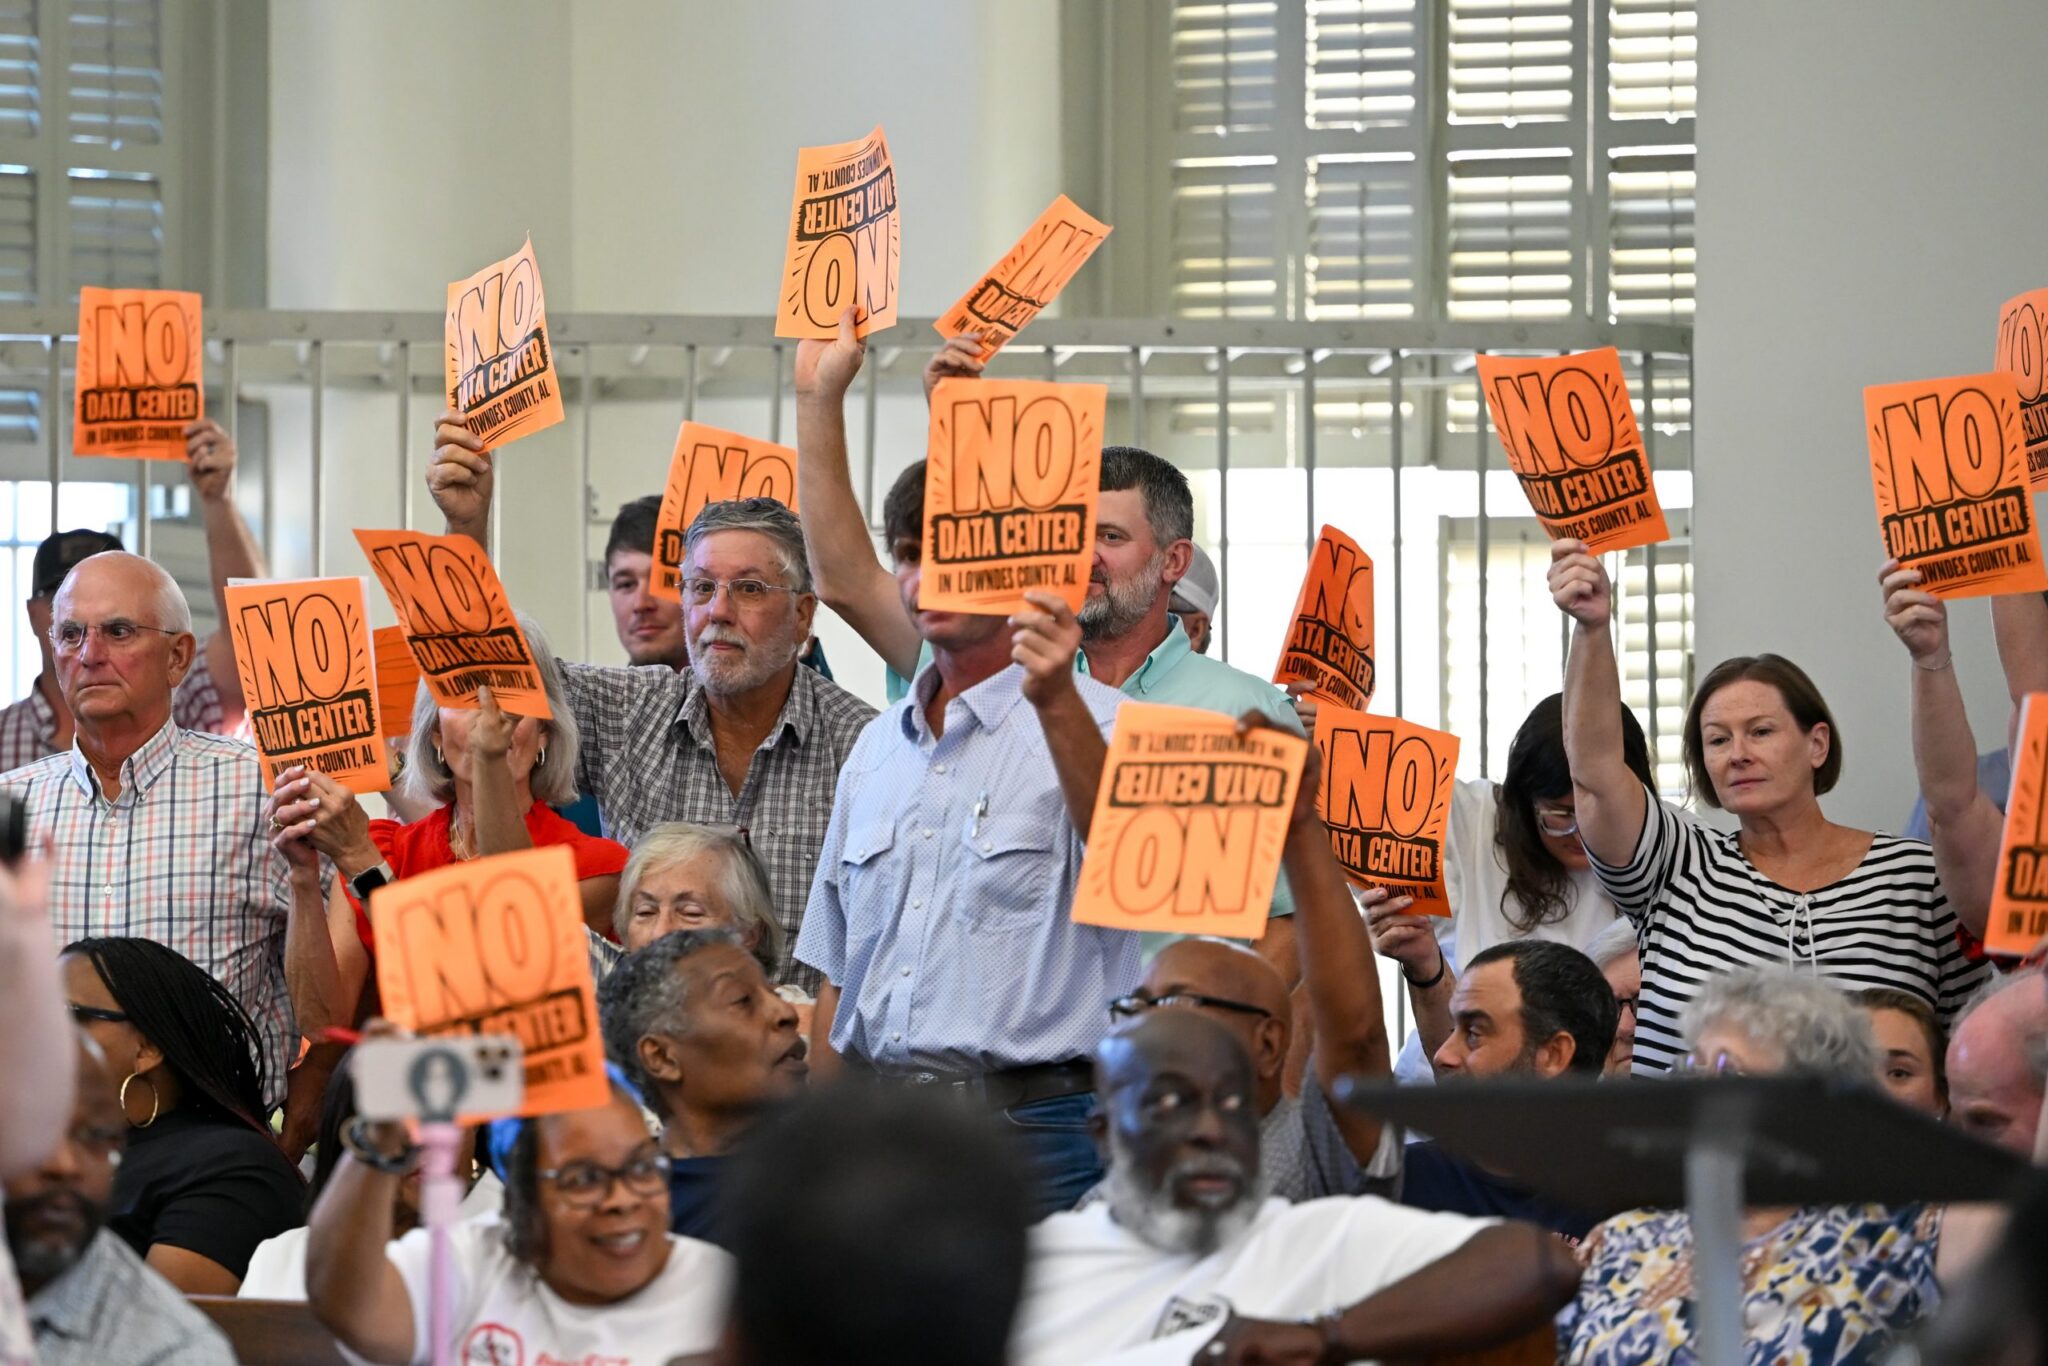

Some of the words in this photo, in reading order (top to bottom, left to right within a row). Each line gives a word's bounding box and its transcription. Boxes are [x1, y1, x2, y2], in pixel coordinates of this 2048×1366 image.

[808, 174, 819, 193] AL
[822, 163, 856, 191] COUNTY,
[867, 171, 894, 218] DATA
[803, 190, 865, 234] CENTER
[803, 213, 890, 329] NO
[458, 257, 535, 377] NO
[95, 301, 191, 389] NO
[488, 337, 545, 394] CENTER
[86, 391, 132, 421] DATA
[135, 388, 197, 418] CENTER
[504, 386, 541, 416] COUNTY,
[538, 378, 551, 399] AL
[1494, 367, 1614, 477] NO
[951, 395, 1076, 515] NO
[1882, 387, 2005, 514] NO
[1560, 458, 1642, 512] CENTER
[937, 516, 997, 560] DATA
[1001, 511, 1082, 555] CENTER
[1588, 507, 1637, 536] COUNTY,
[1635, 499, 1651, 518] AL
[1888, 511, 1944, 558] DATA
[1944, 494, 2025, 546] CENTER
[938, 573, 952, 593] IN
[958, 567, 1014, 593] LOWNDES
[1017, 564, 1060, 588] COUNTY,
[1063, 563, 1077, 585] AL
[1914, 556, 1968, 586] OWNDES
[1968, 546, 2015, 575] COUNTY,
[2016, 542, 2031, 564] AL
[373, 541, 492, 637] NO
[241, 593, 351, 710] NO
[412, 638, 468, 672] DATA
[459, 634, 525, 666] CENTER
[1286, 656, 1328, 688] LOWNDES
[1292, 621, 1326, 657] ATA
[1327, 634, 1374, 693] CENTER
[257, 713, 298, 751] DATA
[296, 698, 371, 745] CENTER
[316, 747, 362, 774] COUNTY,
[362, 743, 376, 766] AL
[1115, 764, 1211, 804] CENTER
[1213, 764, 1283, 805] DATA
[1327, 728, 1437, 838] NO
[1109, 806, 1261, 917] NO
[1332, 830, 1362, 869] ATA
[1367, 836, 1433, 878] CENTER
[2012, 851, 2048, 899] DA
[1424, 886, 1438, 899] AL
[2007, 909, 2024, 934] IN
[396, 869, 557, 1030] NO
